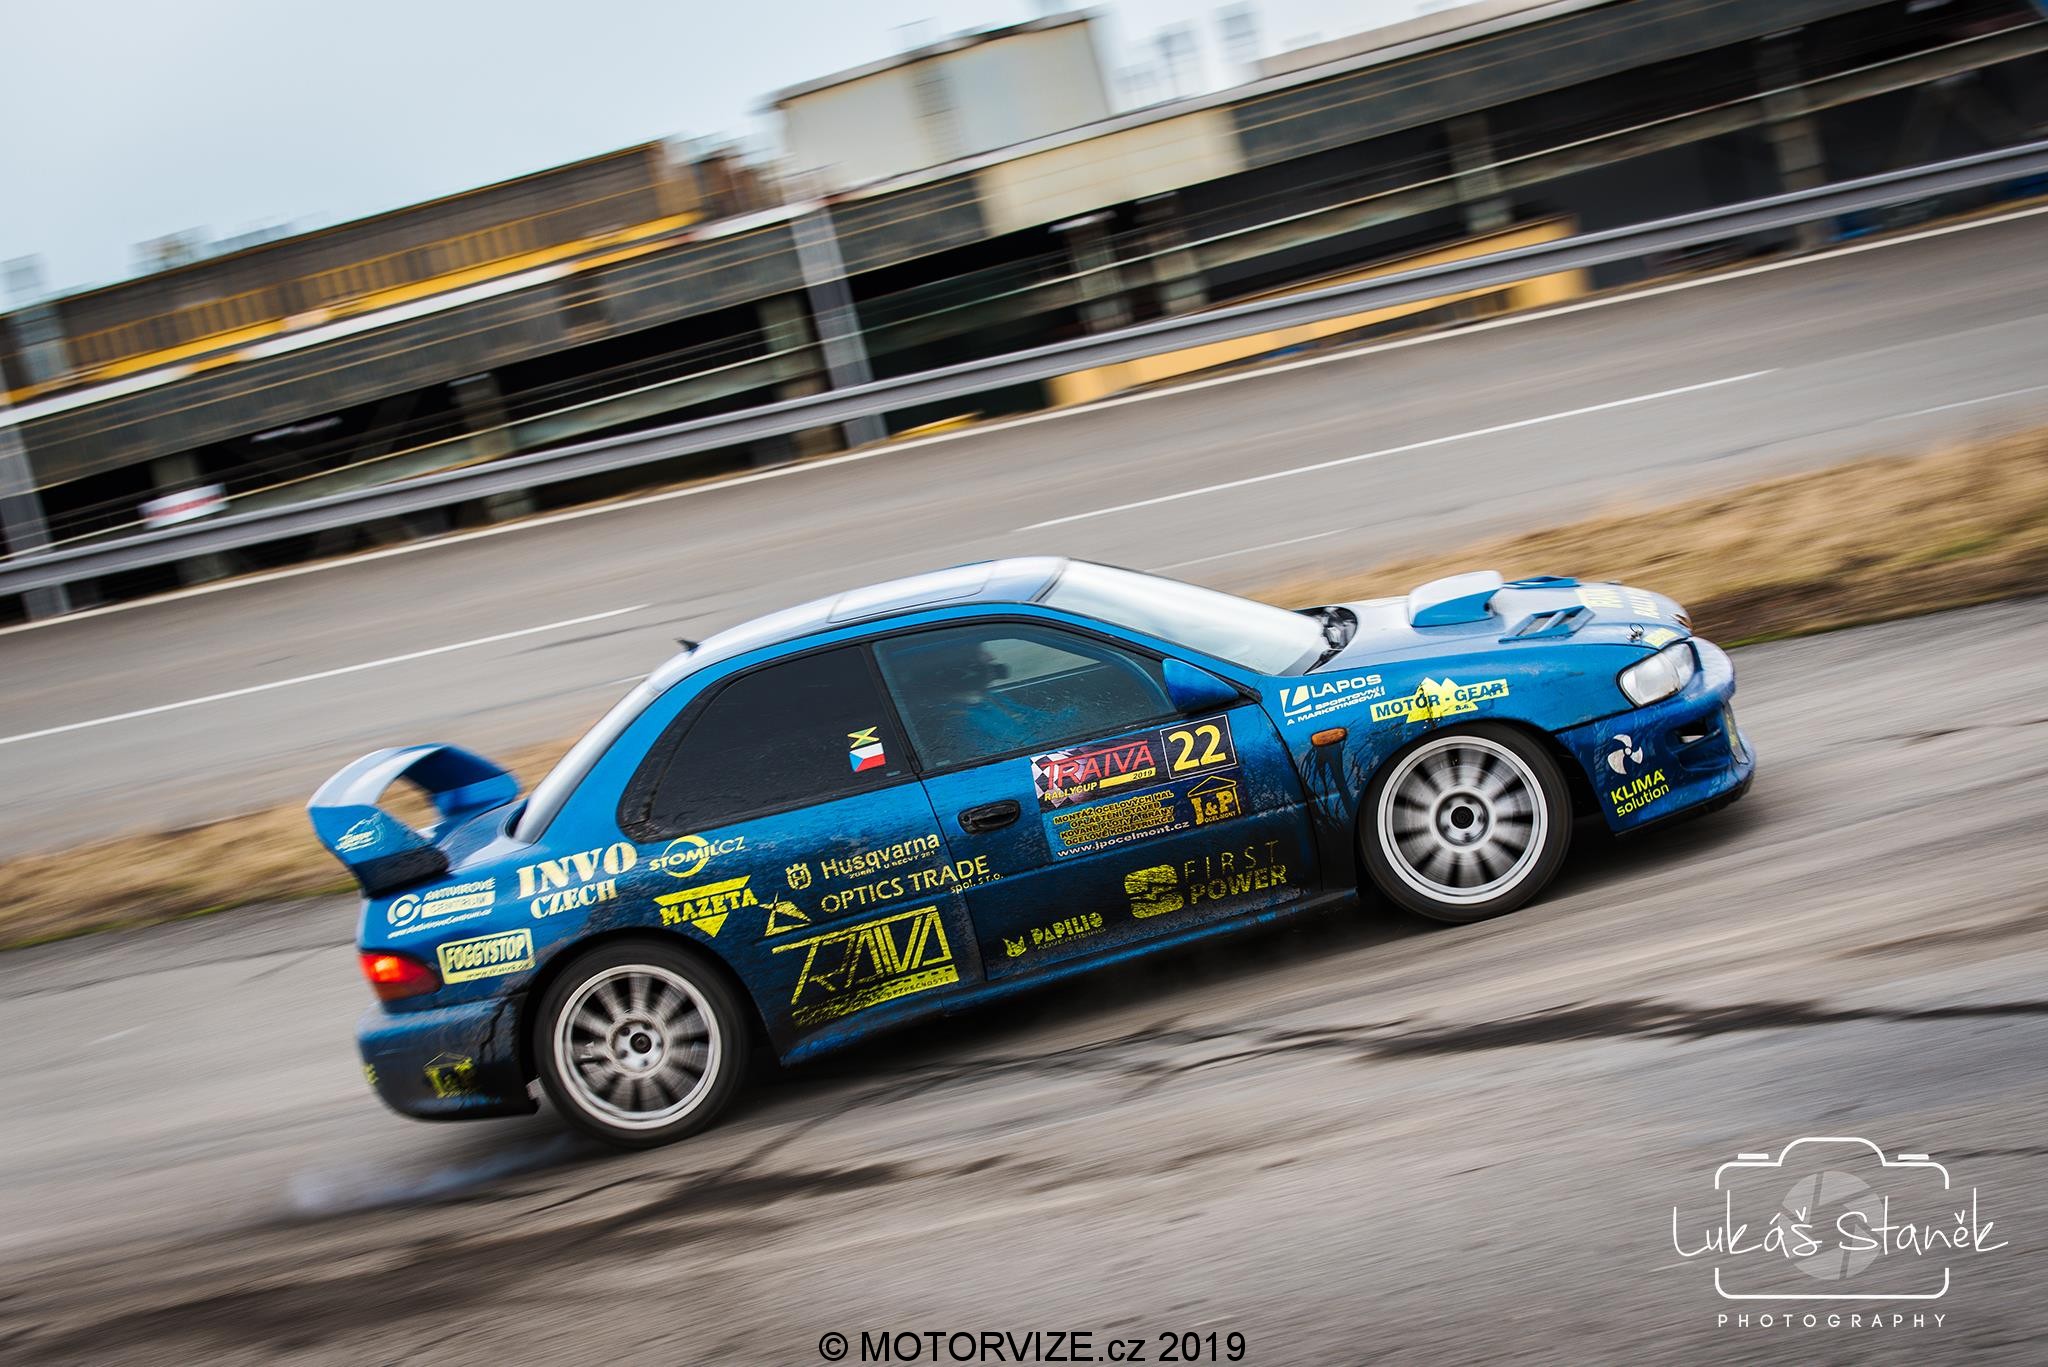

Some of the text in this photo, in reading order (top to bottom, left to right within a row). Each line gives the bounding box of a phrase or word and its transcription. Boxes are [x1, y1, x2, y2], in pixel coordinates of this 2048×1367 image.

[1311, 674, 1382, 698] LAPOS
[1376, 688, 1441, 718] MOTOR
[1454, 683, 1504, 702] GEAR
[1287, 718, 1295, 726] A
[1040, 740, 1155, 790] TRAIVA
[1168, 724, 1227, 772] 22
[1044, 781, 1098, 801] RALLYCUP
[1133, 770, 1153, 780] 2019
[1610, 768, 1666, 805] KLIMA
[1153, 790, 1175, 801] HAL
[1616, 783, 1670, 817] solution
[820, 833, 941, 880] Husqvarna
[1057, 820, 1191, 857] www.jpocelmont.cz
[515, 841, 638, 900] INVO
[1184, 840, 1279, 879] FIRST
[529, 878, 618, 920] CZECH
[820, 854, 990, 914] OPTICS TRADE
[950, 879, 976, 895] spol.
[1189, 864, 1287, 904] POWER
[659, 887, 759, 926] MAZETA
[1030, 912, 1104, 945] PAPILIO
[445, 935, 526, 972] FOGGYSTOP
